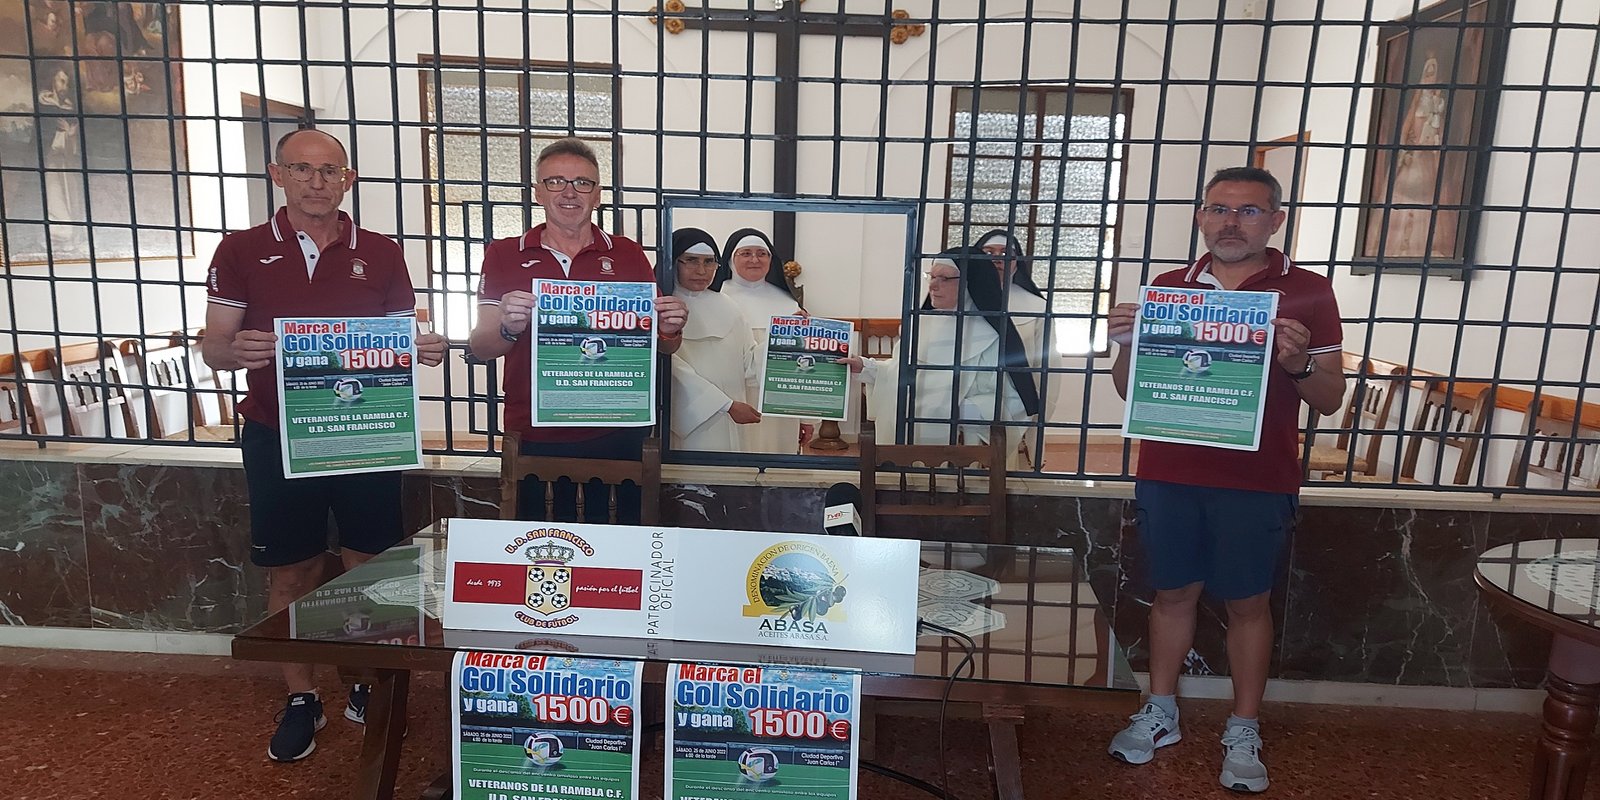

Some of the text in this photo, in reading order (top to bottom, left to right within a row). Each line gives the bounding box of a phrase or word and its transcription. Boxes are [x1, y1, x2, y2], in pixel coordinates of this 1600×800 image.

[540, 282, 595, 296] Marca el
[540, 294, 651, 312] Gol Solidario
[1146, 290, 1204, 305] Marca el
[540, 314, 578, 325] y gana
[588, 311, 651, 330] 1500 €
[772, 317, 800, 326] Marca
[1143, 302, 1268, 325] Gol Solidario
[284, 321, 346, 334] Marca el
[772, 325, 849, 340] Gol Solidario
[1142, 323, 1182, 335] y gana
[1194, 322, 1266, 344] 1500 €
[284, 333, 410, 351] Gol Solidario
[776, 338, 797, 346] gana
[804, 336, 838, 351] 1500
[286, 355, 329, 368] y gana
[340, 349, 411, 369] 1500 €
[1139, 381, 1255, 397] VETERANOS DE LA RAMBLA C.F.
[1152, 391, 1238, 406] U.D. SAN FRANCISCO
[292, 415, 339, 424] VETERANOS
[362, 412, 395, 420] RAMBLA
[396, 411, 410, 419] C.F.
[308, 422, 395, 434] U.D. SAN FRANCISCO
[505, 528, 594, 556] U. D. SAN FRANCISCO
[777, 544, 789, 553] DE
[790, 543, 821, 556] ORIGEN
[820, 553, 839, 577] BAENA
[487, 579, 502, 587] 1973
[575, 585, 598, 593] pasión
[598, 586, 611, 595] por
[618, 586, 639, 595] fútbol
[647, 531, 664, 635] PATROCINADOR
[660, 558, 675, 610] OFICIAL
[514, 611, 536, 626] CLUB
[535, 619, 547, 628] DE
[759, 618, 829, 634] ABASA
[758, 631, 788, 639] ACEITES
[790, 632, 814, 640] ABASA
[465, 651, 524, 669] Marca
[527, 655, 547, 670] el
[679, 663, 762, 683] Marca el
[463, 666, 631, 700] Gol Solidario
[677, 681, 849, 714] Gol Solidario
[463, 698, 518, 714] y gana
[534, 695, 631, 725] 1500 €
[678, 712, 733, 729] y gana
[750, 709, 849, 740] 1500 €
[468, 778, 529, 792] VETERANOS
[530, 783, 544, 792] DE
[546, 784, 559, 794] LA
[560, 785, 604, 797] RAMBLA
[606, 789, 625, 799] C.F.
